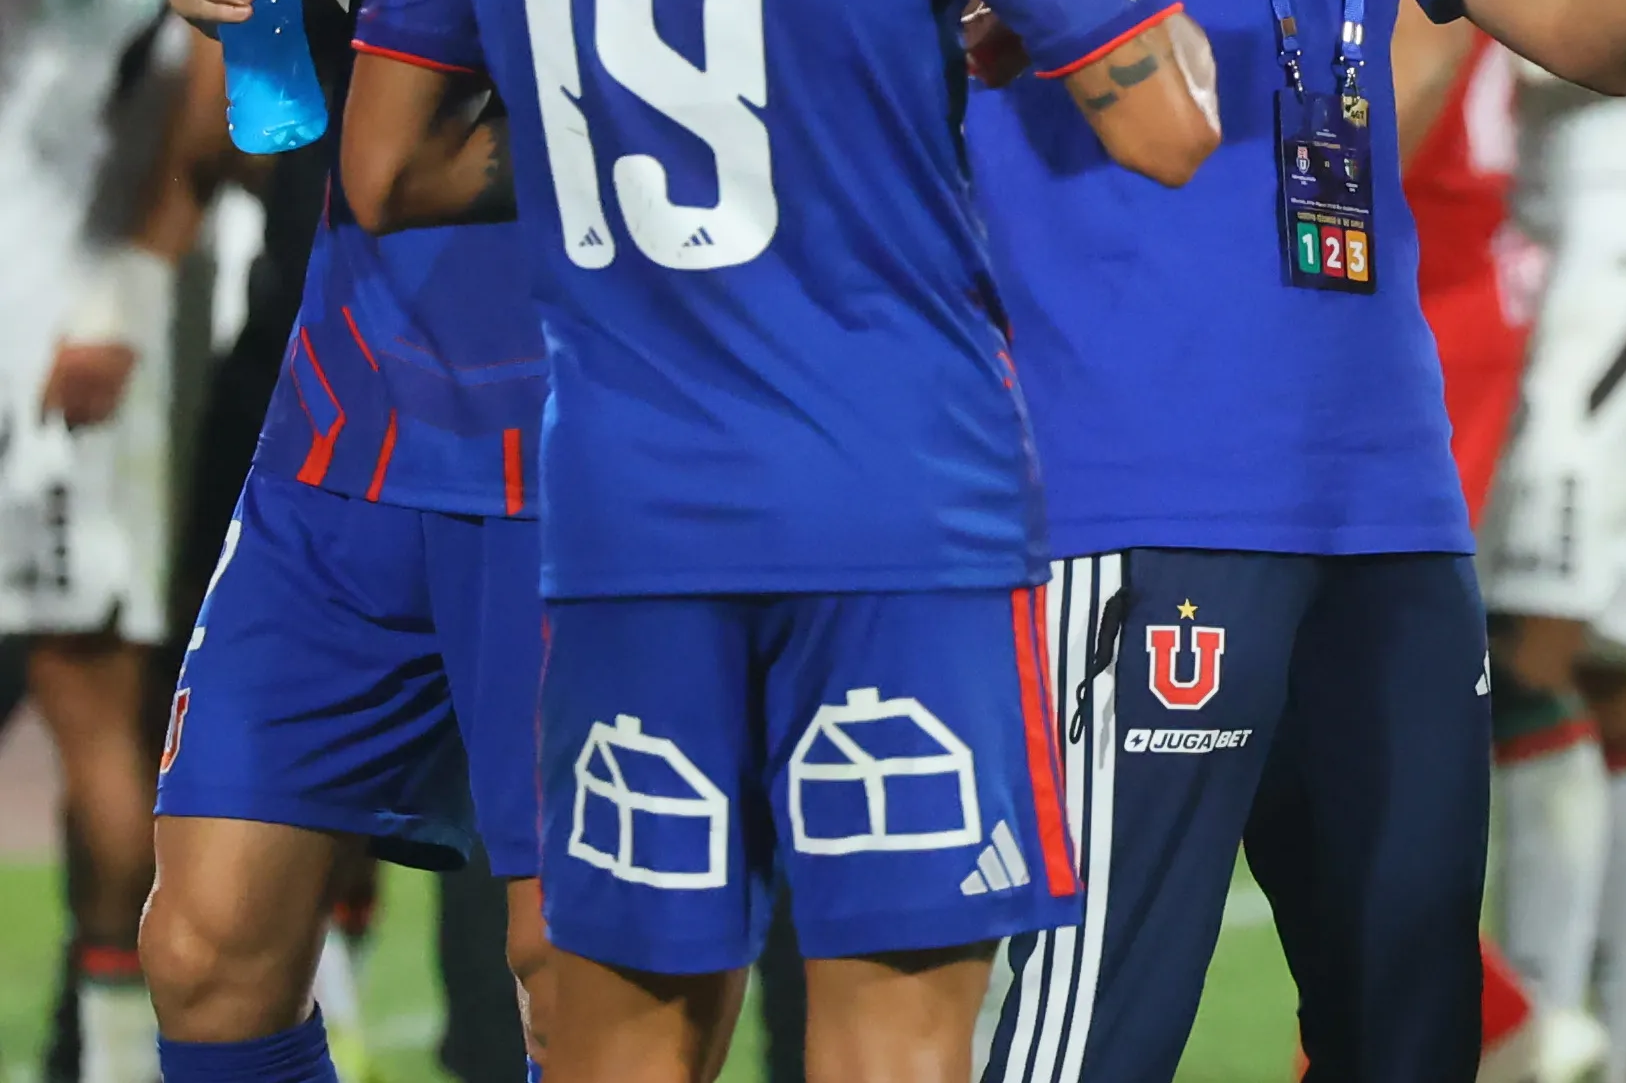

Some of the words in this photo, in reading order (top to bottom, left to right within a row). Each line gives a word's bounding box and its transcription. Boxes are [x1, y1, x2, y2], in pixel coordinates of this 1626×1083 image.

[1302, 233, 1314, 264] 1
[1326, 236, 1342, 268] 2
[1350, 241, 1365, 273] 3
[1146, 625, 1225, 710] U
